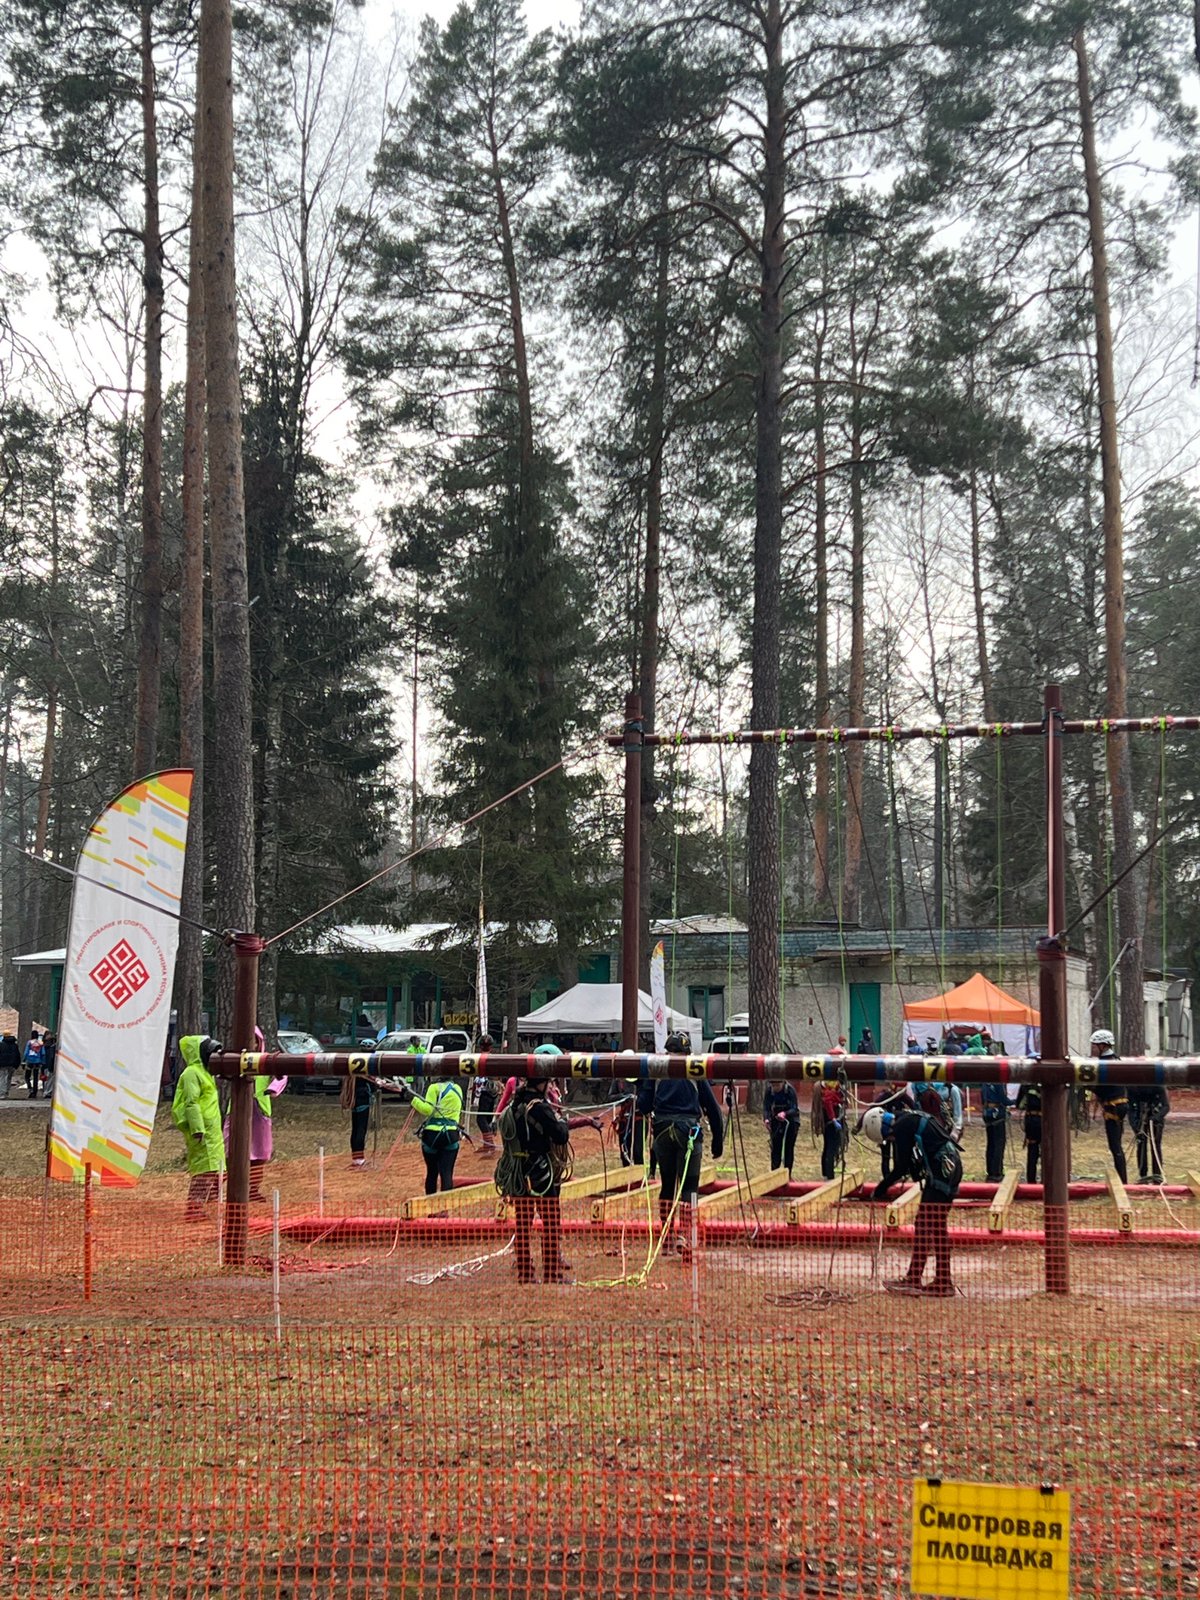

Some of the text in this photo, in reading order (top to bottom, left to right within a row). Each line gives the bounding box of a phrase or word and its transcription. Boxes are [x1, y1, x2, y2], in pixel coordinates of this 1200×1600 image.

[242, 1055, 258, 1073] 1
[351, 1058, 366, 1074] 2
[460, 1057, 476, 1075] 3
[573, 1057, 590, 1075] 4
[688, 1059, 705, 1077] 5
[804, 1060, 821, 1078] 6
[926, 1062, 942, 1079] 7
[1078, 1063, 1096, 1081] 8
[789, 1206, 797, 1224] 5
[888, 1210, 896, 1225] 6
[991, 1213, 999, 1228] 7
[1121, 1213, 1130, 1228] 8
[919, 1503, 1063, 1541] Смотровая
[926, 1539, 1053, 1571] площадка
